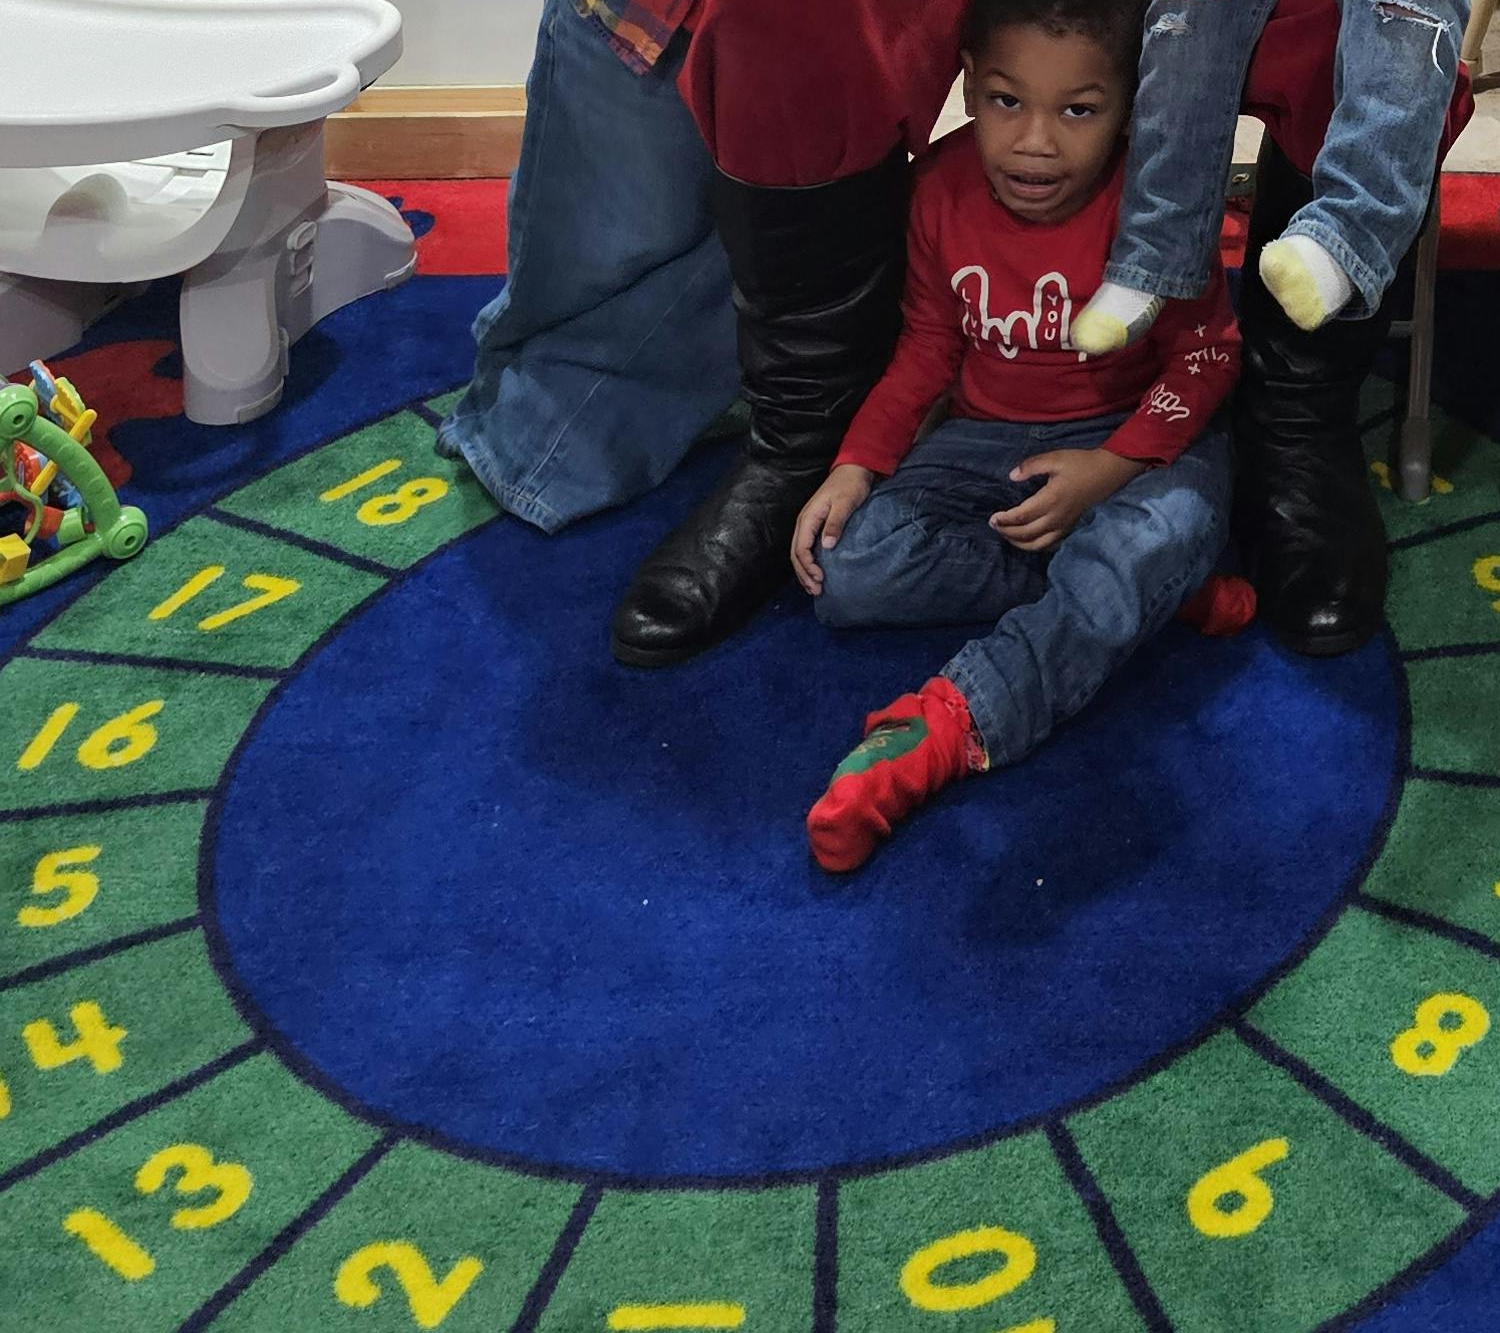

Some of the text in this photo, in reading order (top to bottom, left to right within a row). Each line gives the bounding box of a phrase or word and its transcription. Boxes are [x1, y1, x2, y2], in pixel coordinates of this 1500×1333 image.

[320, 458, 449, 528] 18
[147, 564, 301, 632] 17
[15, 697, 167, 772] 16
[1389, 991, 1490, 1076] 8
[61, 1142, 254, 1282] 13
